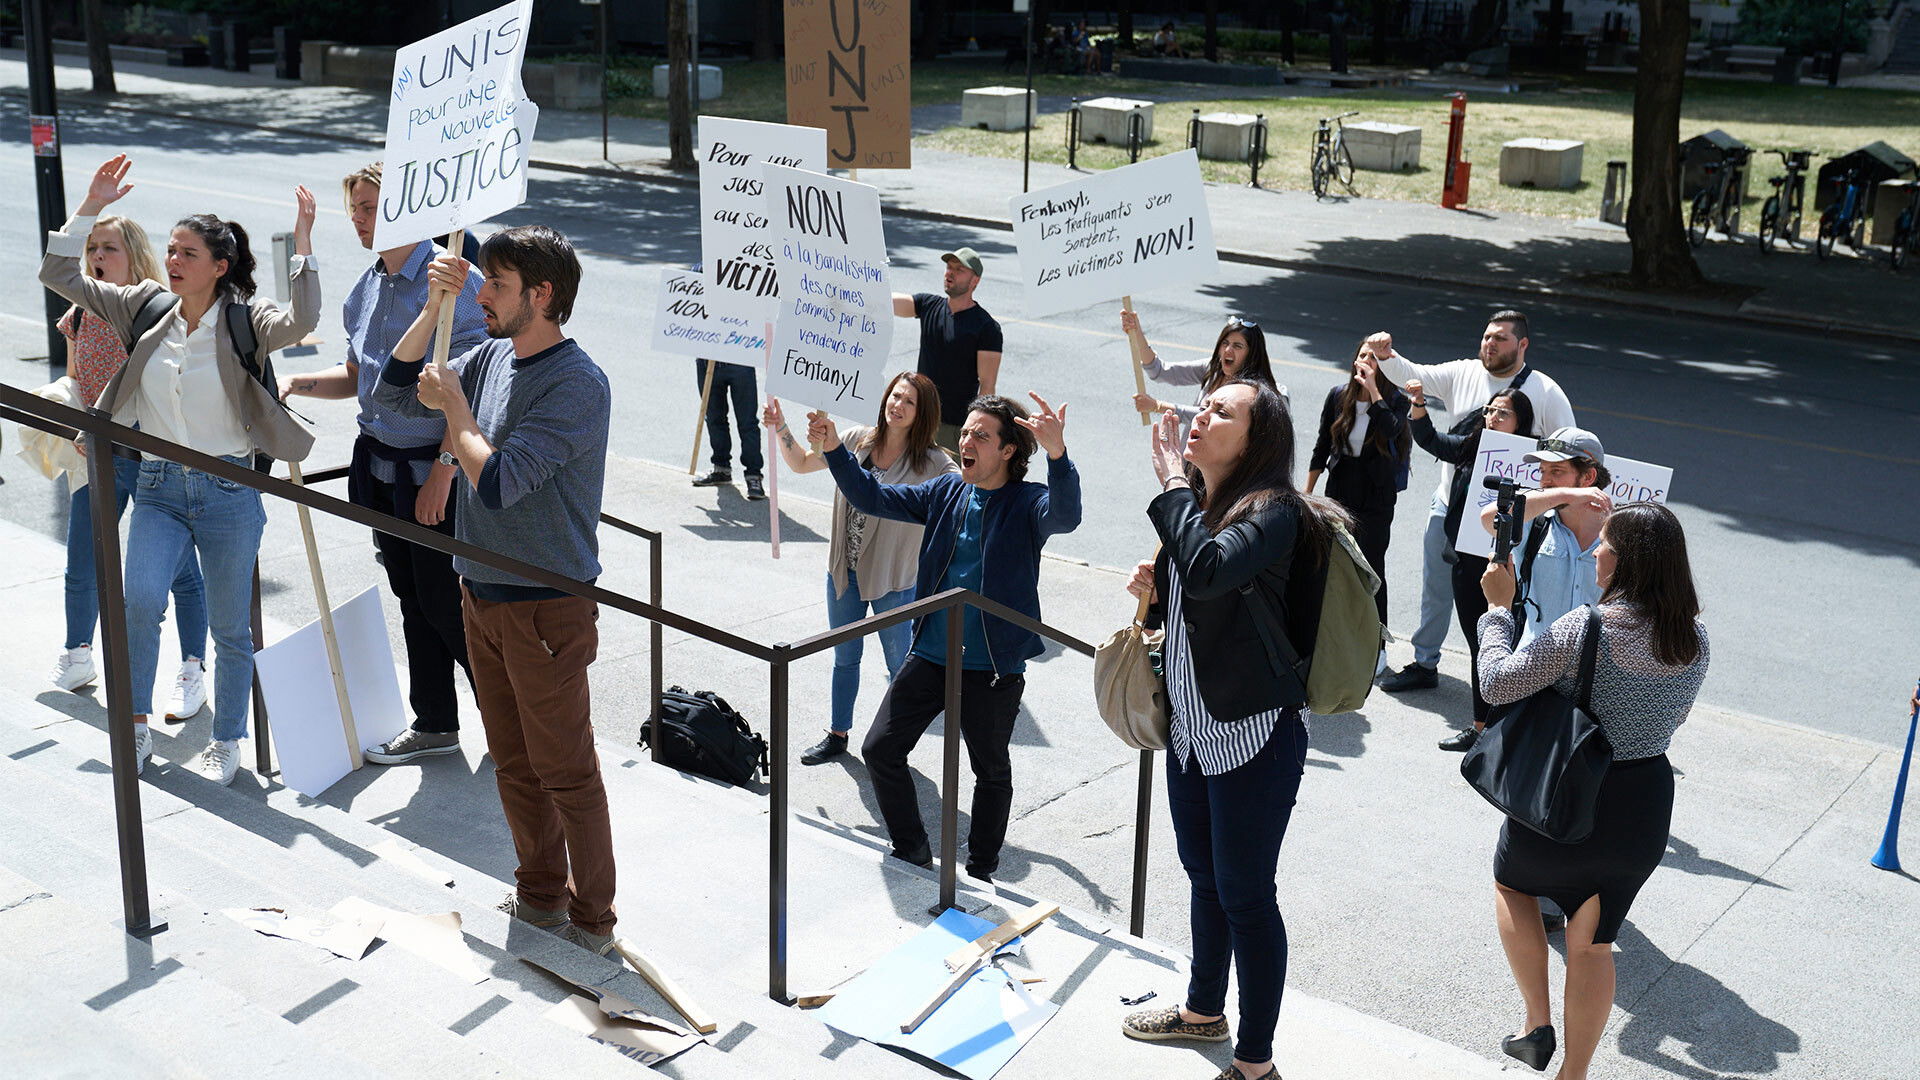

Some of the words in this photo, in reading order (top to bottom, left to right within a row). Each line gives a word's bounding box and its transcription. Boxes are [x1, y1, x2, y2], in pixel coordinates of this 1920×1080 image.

[419, 17, 521, 89] UNIS
[708, 142, 752, 167] Pour
[714, 210, 741, 225] au
[786, 185, 848, 244] NON
[1041, 222, 1062, 241] Les
[742, 242, 774, 260] des
[783, 238, 793, 260] à
[797, 241, 811, 265] la
[1037, 267, 1061, 286] Les
[1067, 249, 1123, 277] victimes
[1133, 217, 1195, 264] NON!
[800, 273, 823, 295] des
[666, 299, 709, 320] NON
[839, 312, 858, 335] par
[861, 315, 877, 335] les
[799, 328, 847, 354] vendeurs
[849, 341, 864, 358] de
